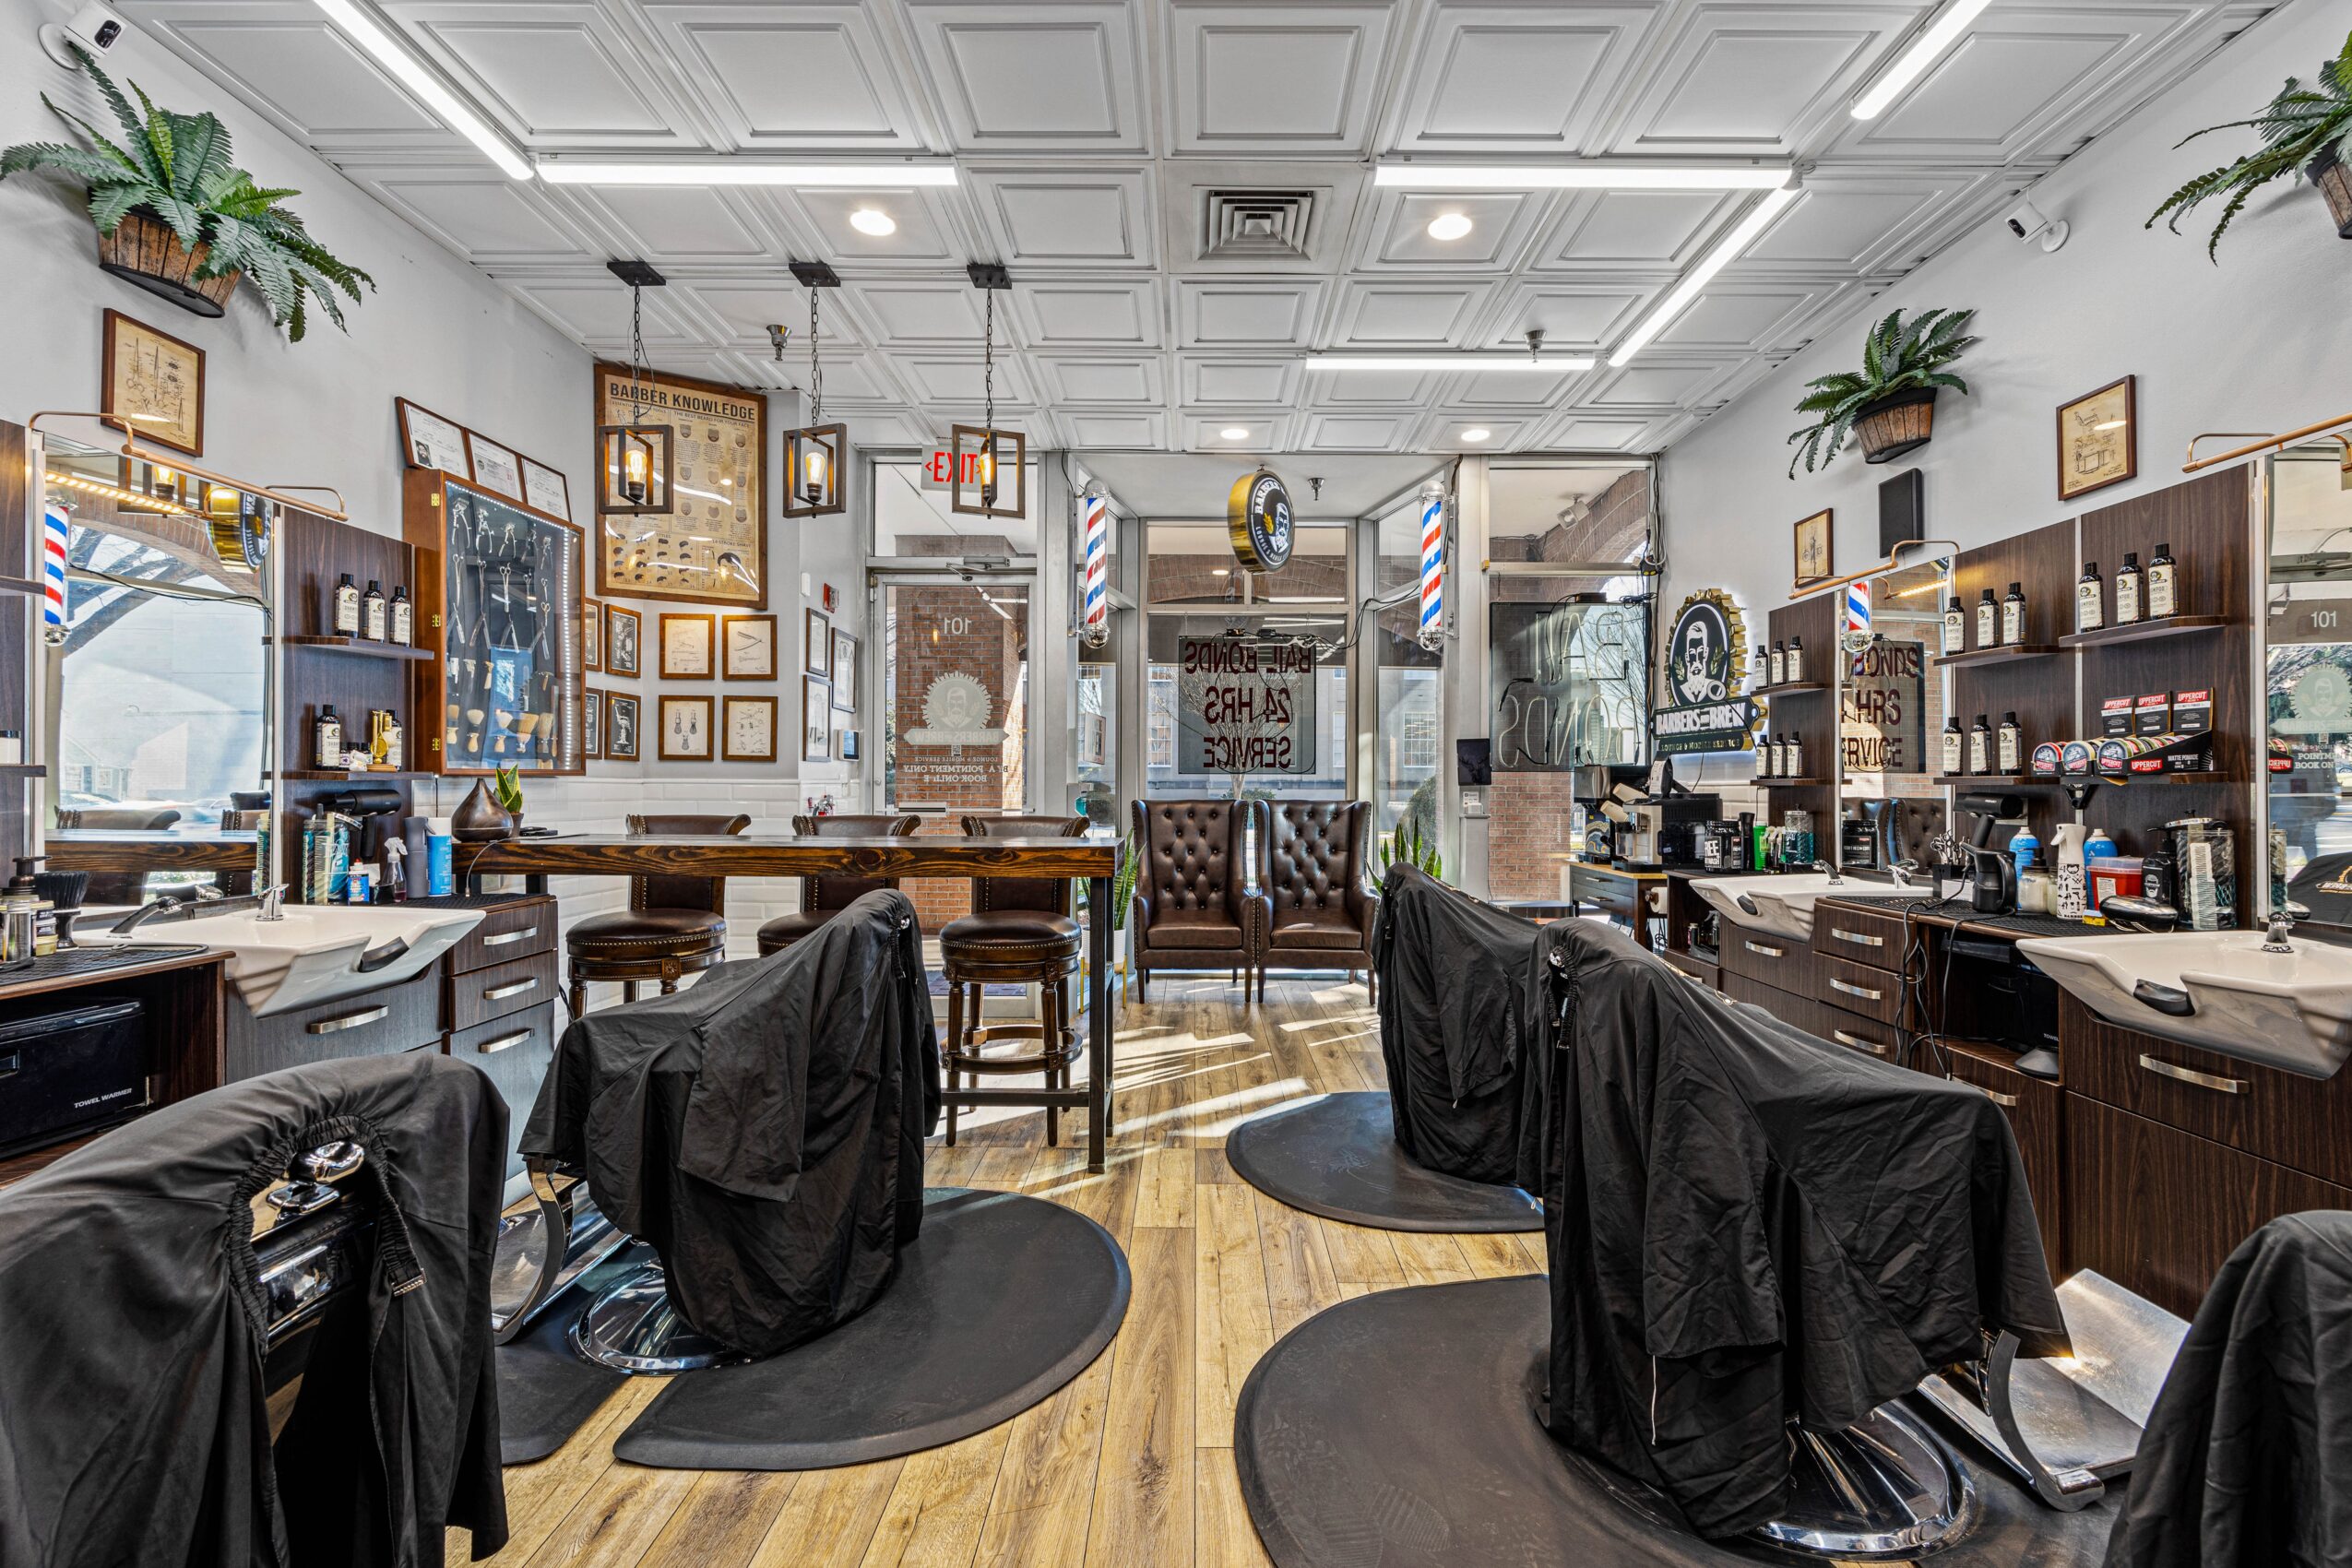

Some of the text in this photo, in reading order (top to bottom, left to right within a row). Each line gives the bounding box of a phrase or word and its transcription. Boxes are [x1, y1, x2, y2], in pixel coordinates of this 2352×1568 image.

[610, 383, 755, 421] BARBER KNOWLEDGE
[933, 452, 978, 483] EXIT
[2310, 610, 2337, 628] 101
[1856, 688, 1902, 726] HRS
[2138, 695, 2167, 706] UPPERCUT
[2178, 692, 2208, 702] UPPERCUT
[1656, 708, 1701, 735] BARBERS
[1709, 703, 1746, 730] BREW
[2131, 760, 2162, 770] UPPERCUT
[73, 1088, 132, 1108] TOWEL WARMER
